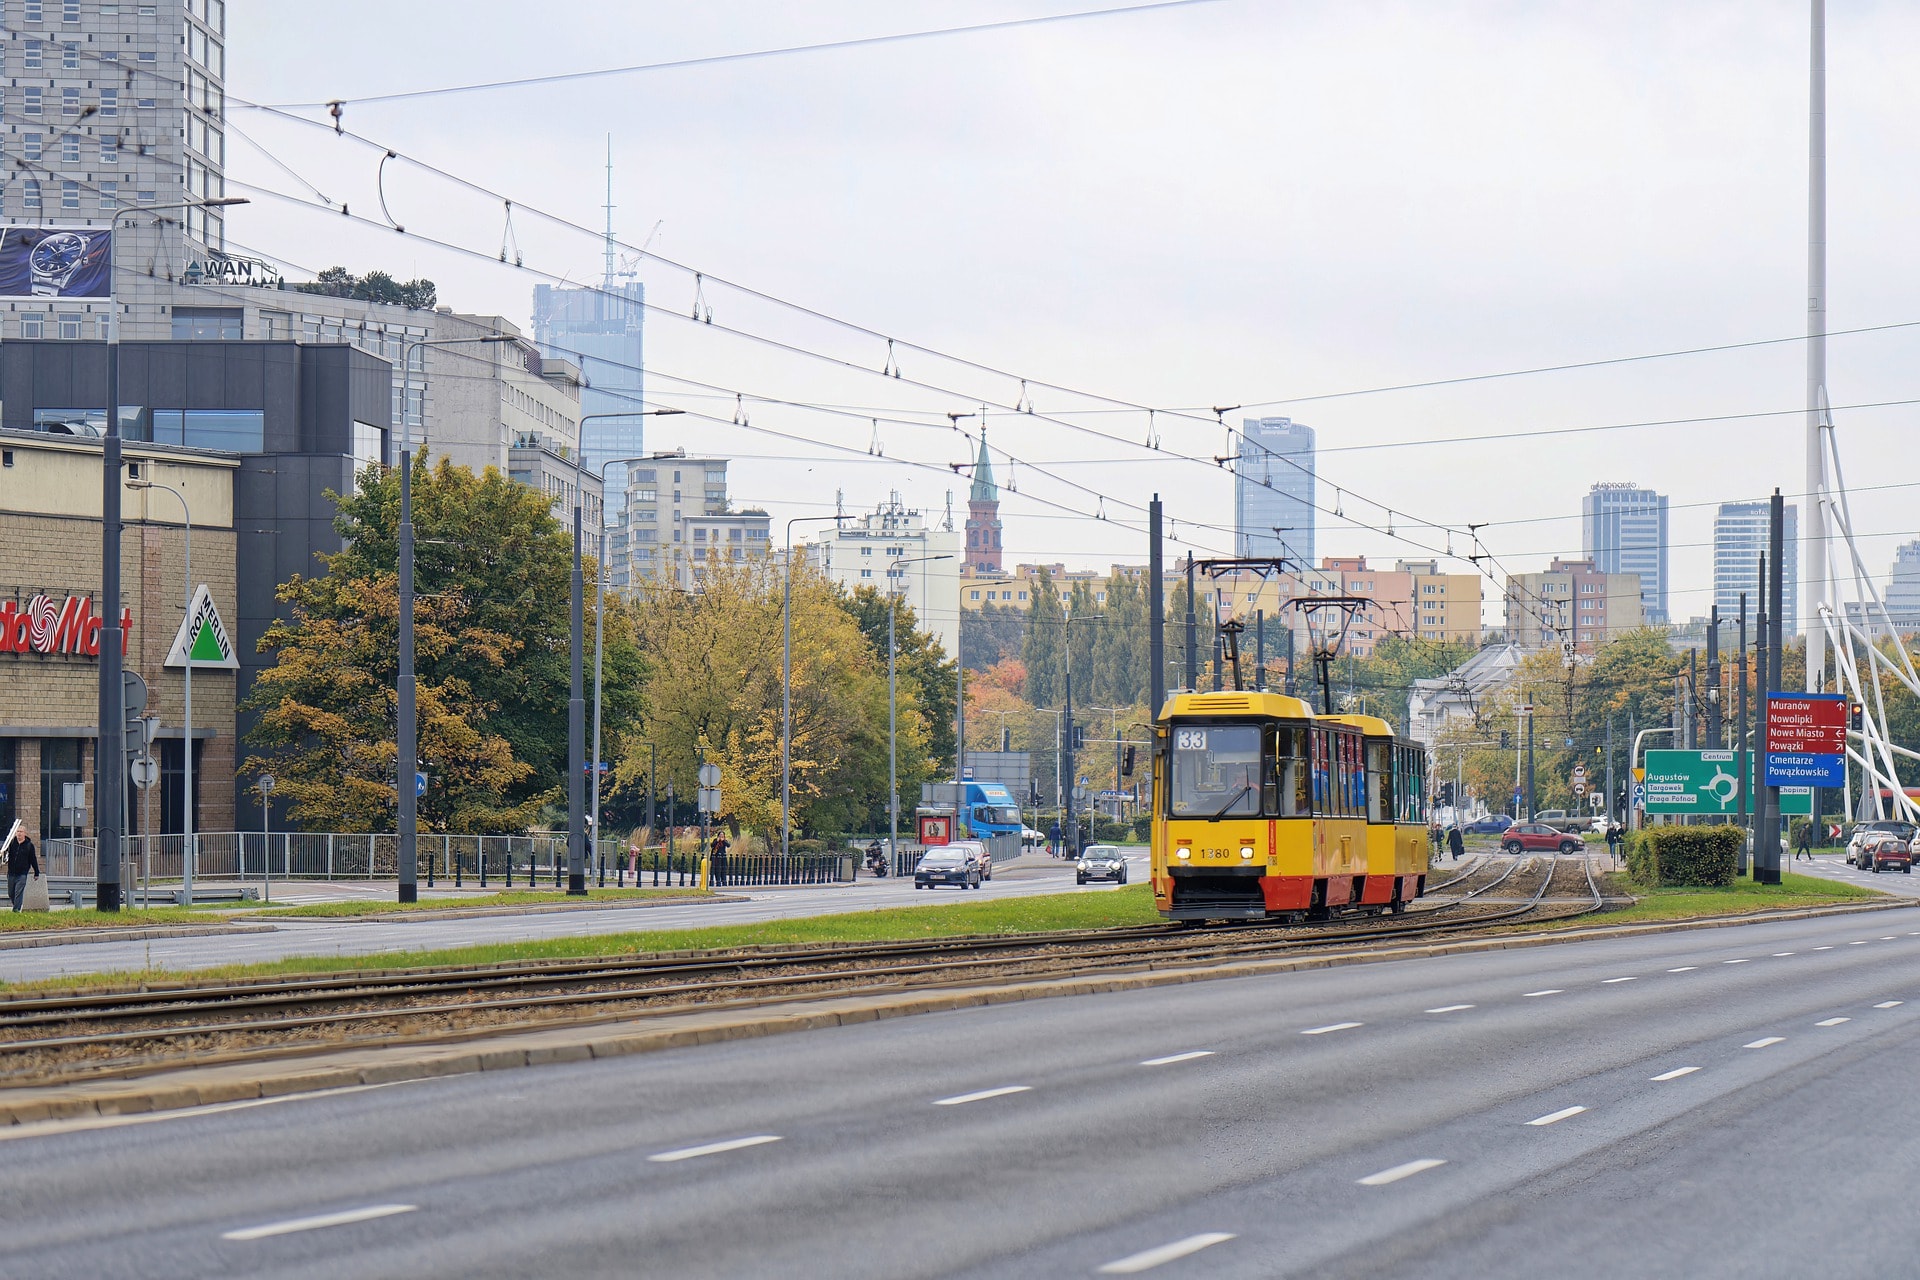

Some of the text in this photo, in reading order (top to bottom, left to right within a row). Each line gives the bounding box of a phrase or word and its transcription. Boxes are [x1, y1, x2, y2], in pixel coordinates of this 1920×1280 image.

[204, 261, 252, 275] WAN
[202, 593, 230, 660] MERLIN
[1770, 701, 1811, 710] Muranów
[1770, 714, 1813, 725] Nowolipki
[1770, 728, 1825, 738] Nowe Miasto
[1181, 731, 1203, 748] 33
[1770, 741, 1804, 752] Powązki
[1769, 755, 1814, 765] Cmentarze
[1769, 766, 1829, 777] Powązkowskie
[1647, 772, 1690, 782] Augustów
[1649, 795, 1669, 803] Praga
[1201, 848, 1230, 858] 1380
